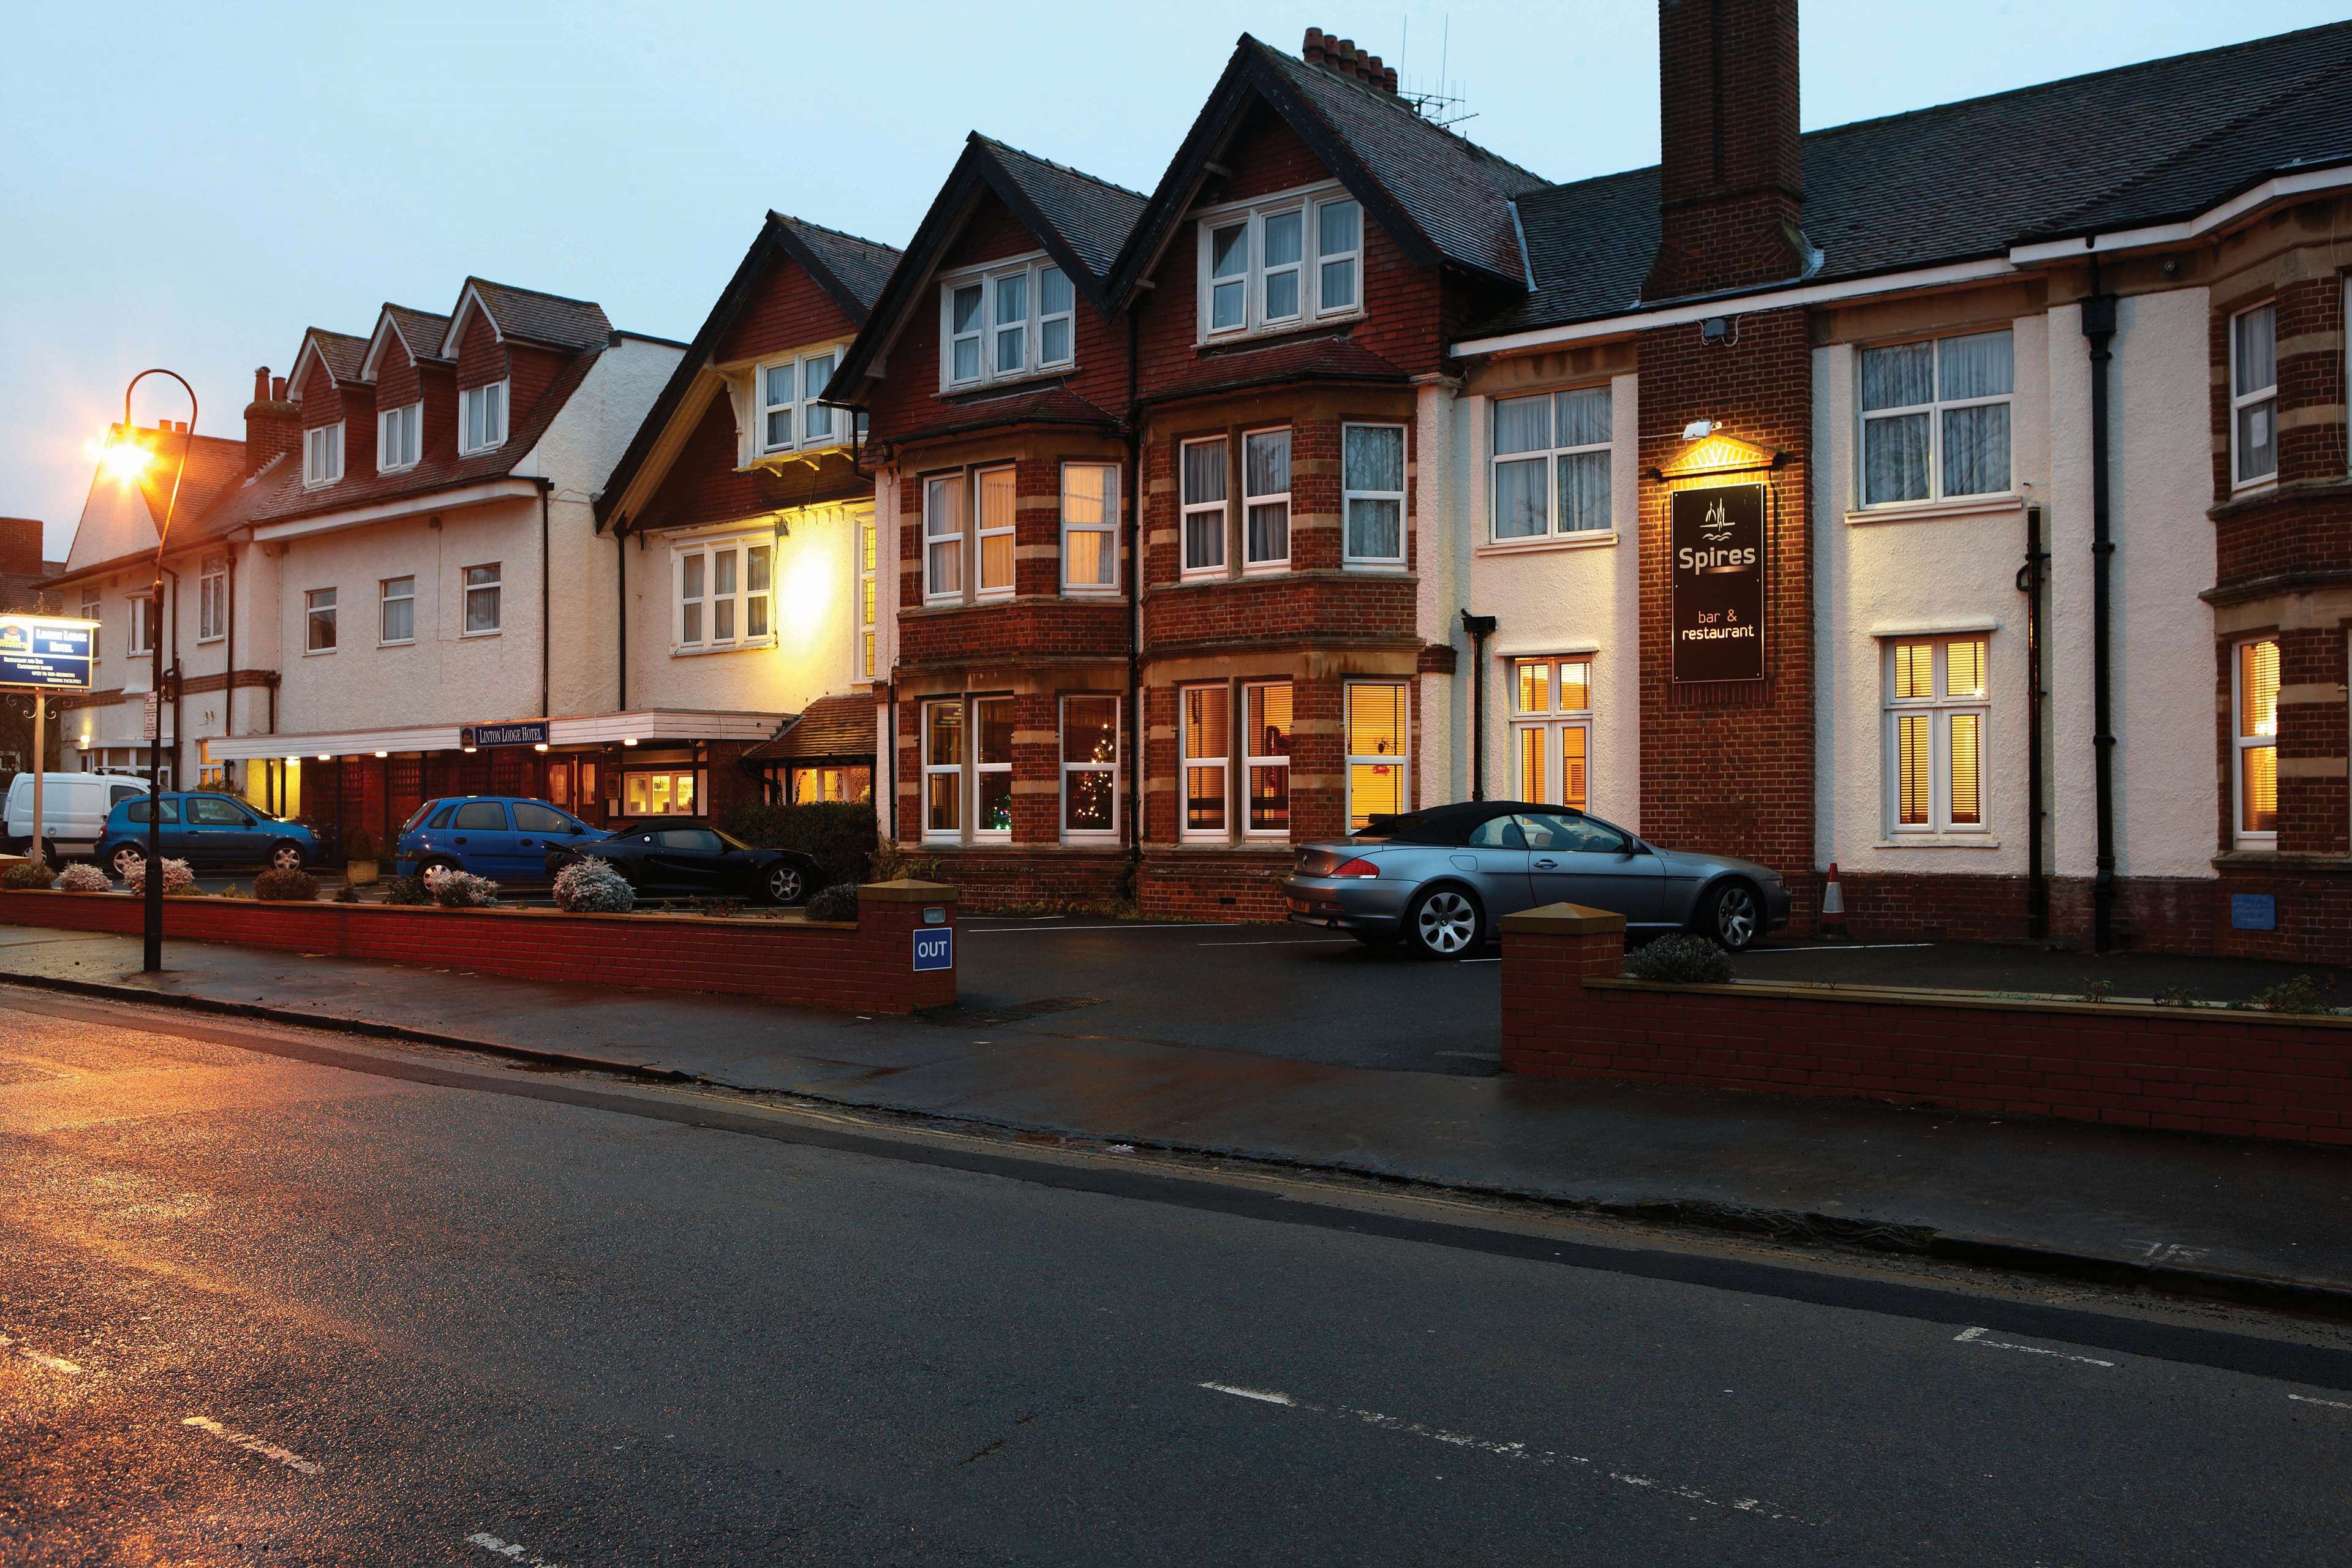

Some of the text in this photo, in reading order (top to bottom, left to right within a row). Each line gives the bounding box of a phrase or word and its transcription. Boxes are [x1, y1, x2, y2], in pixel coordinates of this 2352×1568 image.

[1679, 547, 1756, 575] Spires
[1698, 609, 1737, 624] bar &
[1682, 624, 1754, 640] restaurant
[480, 729, 500, 743] LINTON
[502, 728, 521, 742] LODGE
[522, 726, 542, 741] HOTEL
[918, 941, 947, 957] OUT
